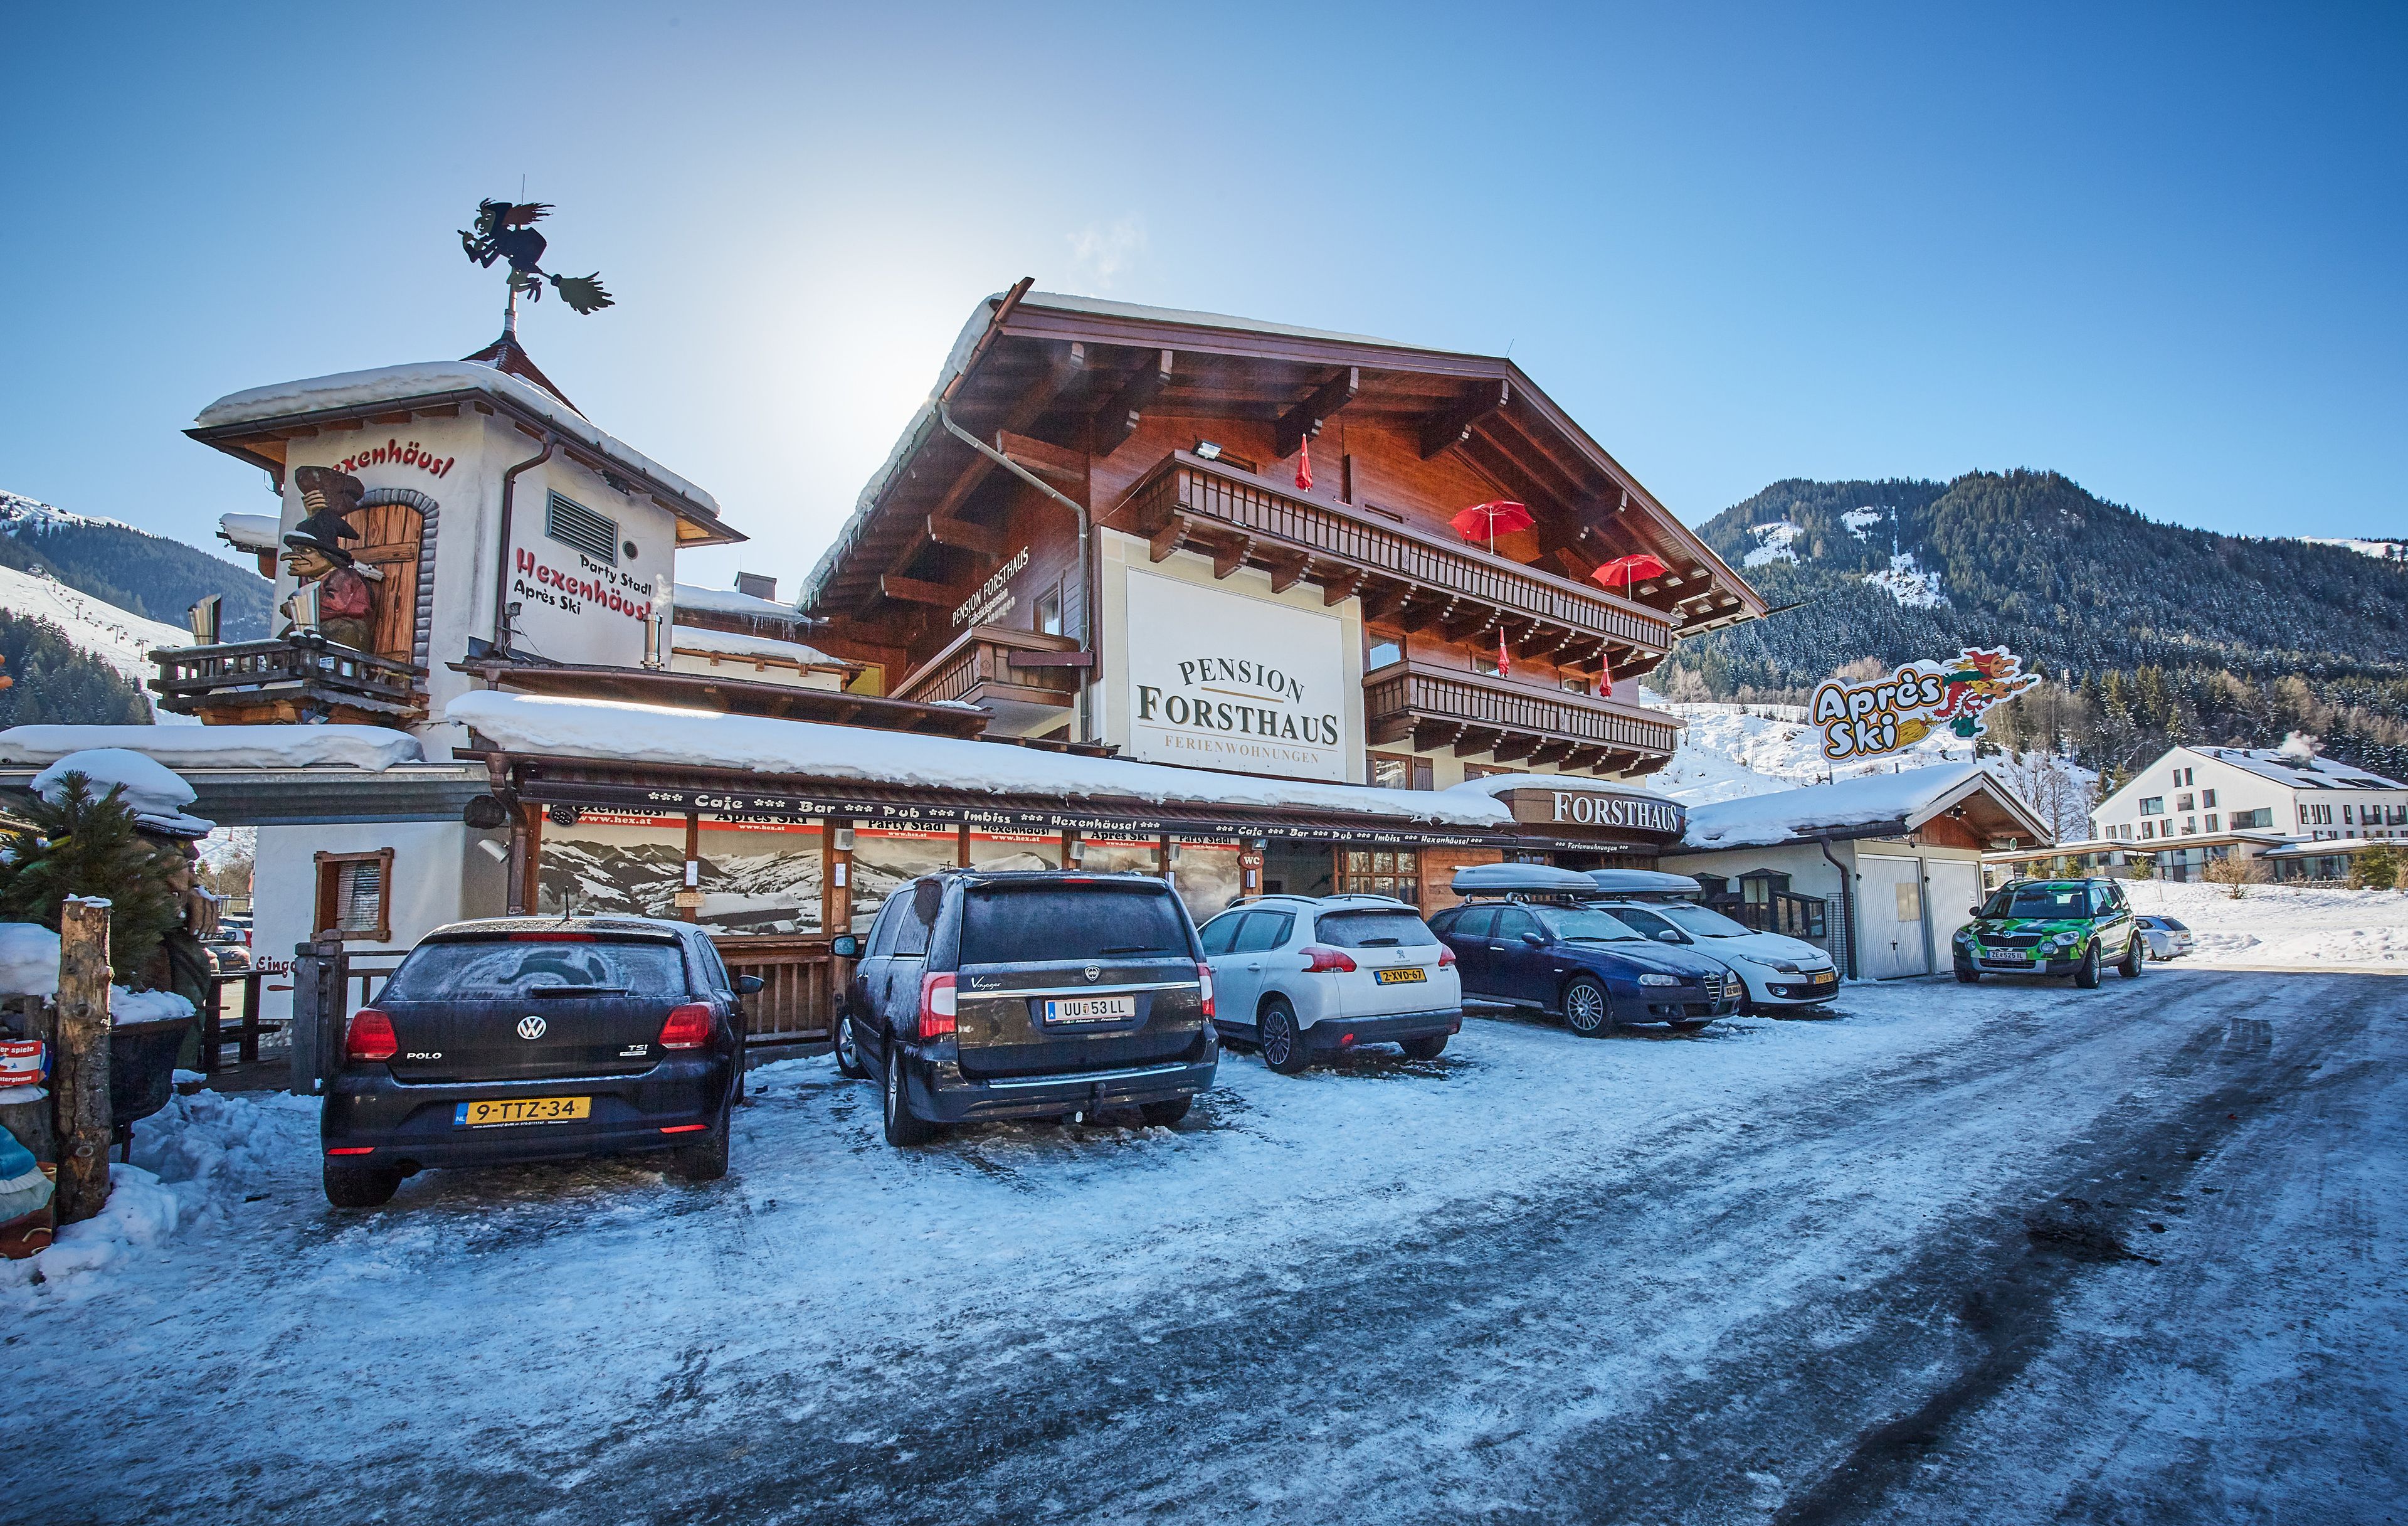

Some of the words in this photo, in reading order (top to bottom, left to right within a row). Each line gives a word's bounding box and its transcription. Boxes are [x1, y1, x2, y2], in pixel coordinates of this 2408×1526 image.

[332, 439, 455, 479] exenhäusl
[516, 547, 652, 620] Hexenhäusl
[580, 554, 617, 584] Party
[620, 573, 652, 596] Stadl
[953, 588, 981, 628] PENSION
[983, 546, 1029, 600] FORSTHAUS
[514, 579, 556, 606] Après
[559, 596, 581, 615] Ski
[1178, 658, 1305, 704] PENSION
[1815, 669, 1944, 723] Après
[1136, 684, 1339, 746] FORSTHAUS
[1164, 734, 1319, 764] FERIENWOHNUNGEN
[1826, 713, 1898, 755] Ski
[798, 800, 836, 813] Bar
[882, 805, 920, 818] Pub
[964, 810, 1011, 824] Imbiss
[1051, 815, 1137, 830] Hexenhäusel
[867, 820, 907, 832] Party
[911, 822, 946, 832] Stadl
[1551, 791, 1677, 832] FORSTHAUS
[1179, 835, 1205, 844] Party
[1289, 828, 1309, 837] Bar
[1333, 831, 1352, 840] Pub
[1375, 833, 1400, 842] Imbiss
[1244, 856, 1260, 865] WC
[971, 976, 1002, 990] Voyager
[1383, 970, 1422, 982] 2-XVD-67
[11, 1046, 34, 1054] spiele
[476, 1099, 575, 1121] 9-TTZ-34
